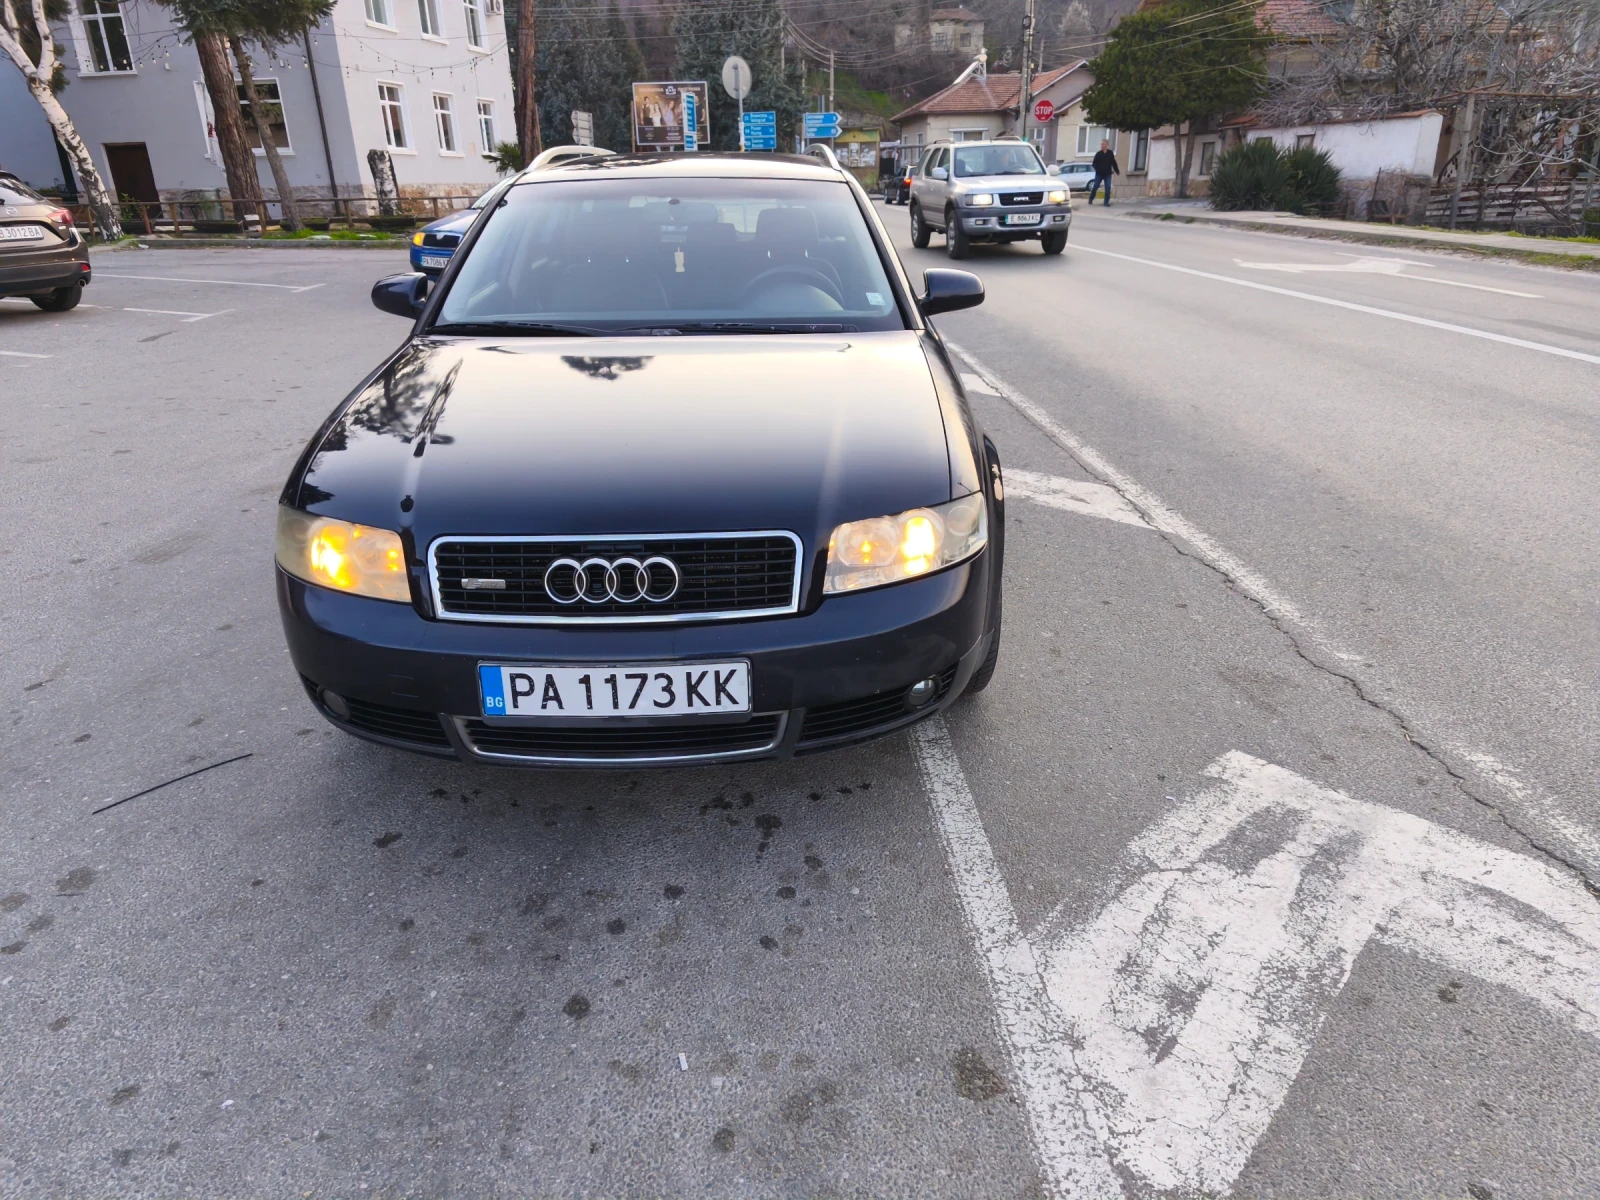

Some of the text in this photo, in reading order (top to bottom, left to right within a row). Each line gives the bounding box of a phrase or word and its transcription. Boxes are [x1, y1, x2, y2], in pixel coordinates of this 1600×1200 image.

[1035, 106, 1053, 115] STOP
[6, 228, 28, 238] 3012
[28, 228, 41, 236] BA
[486, 669, 740, 710] BG PA 1173 KK
